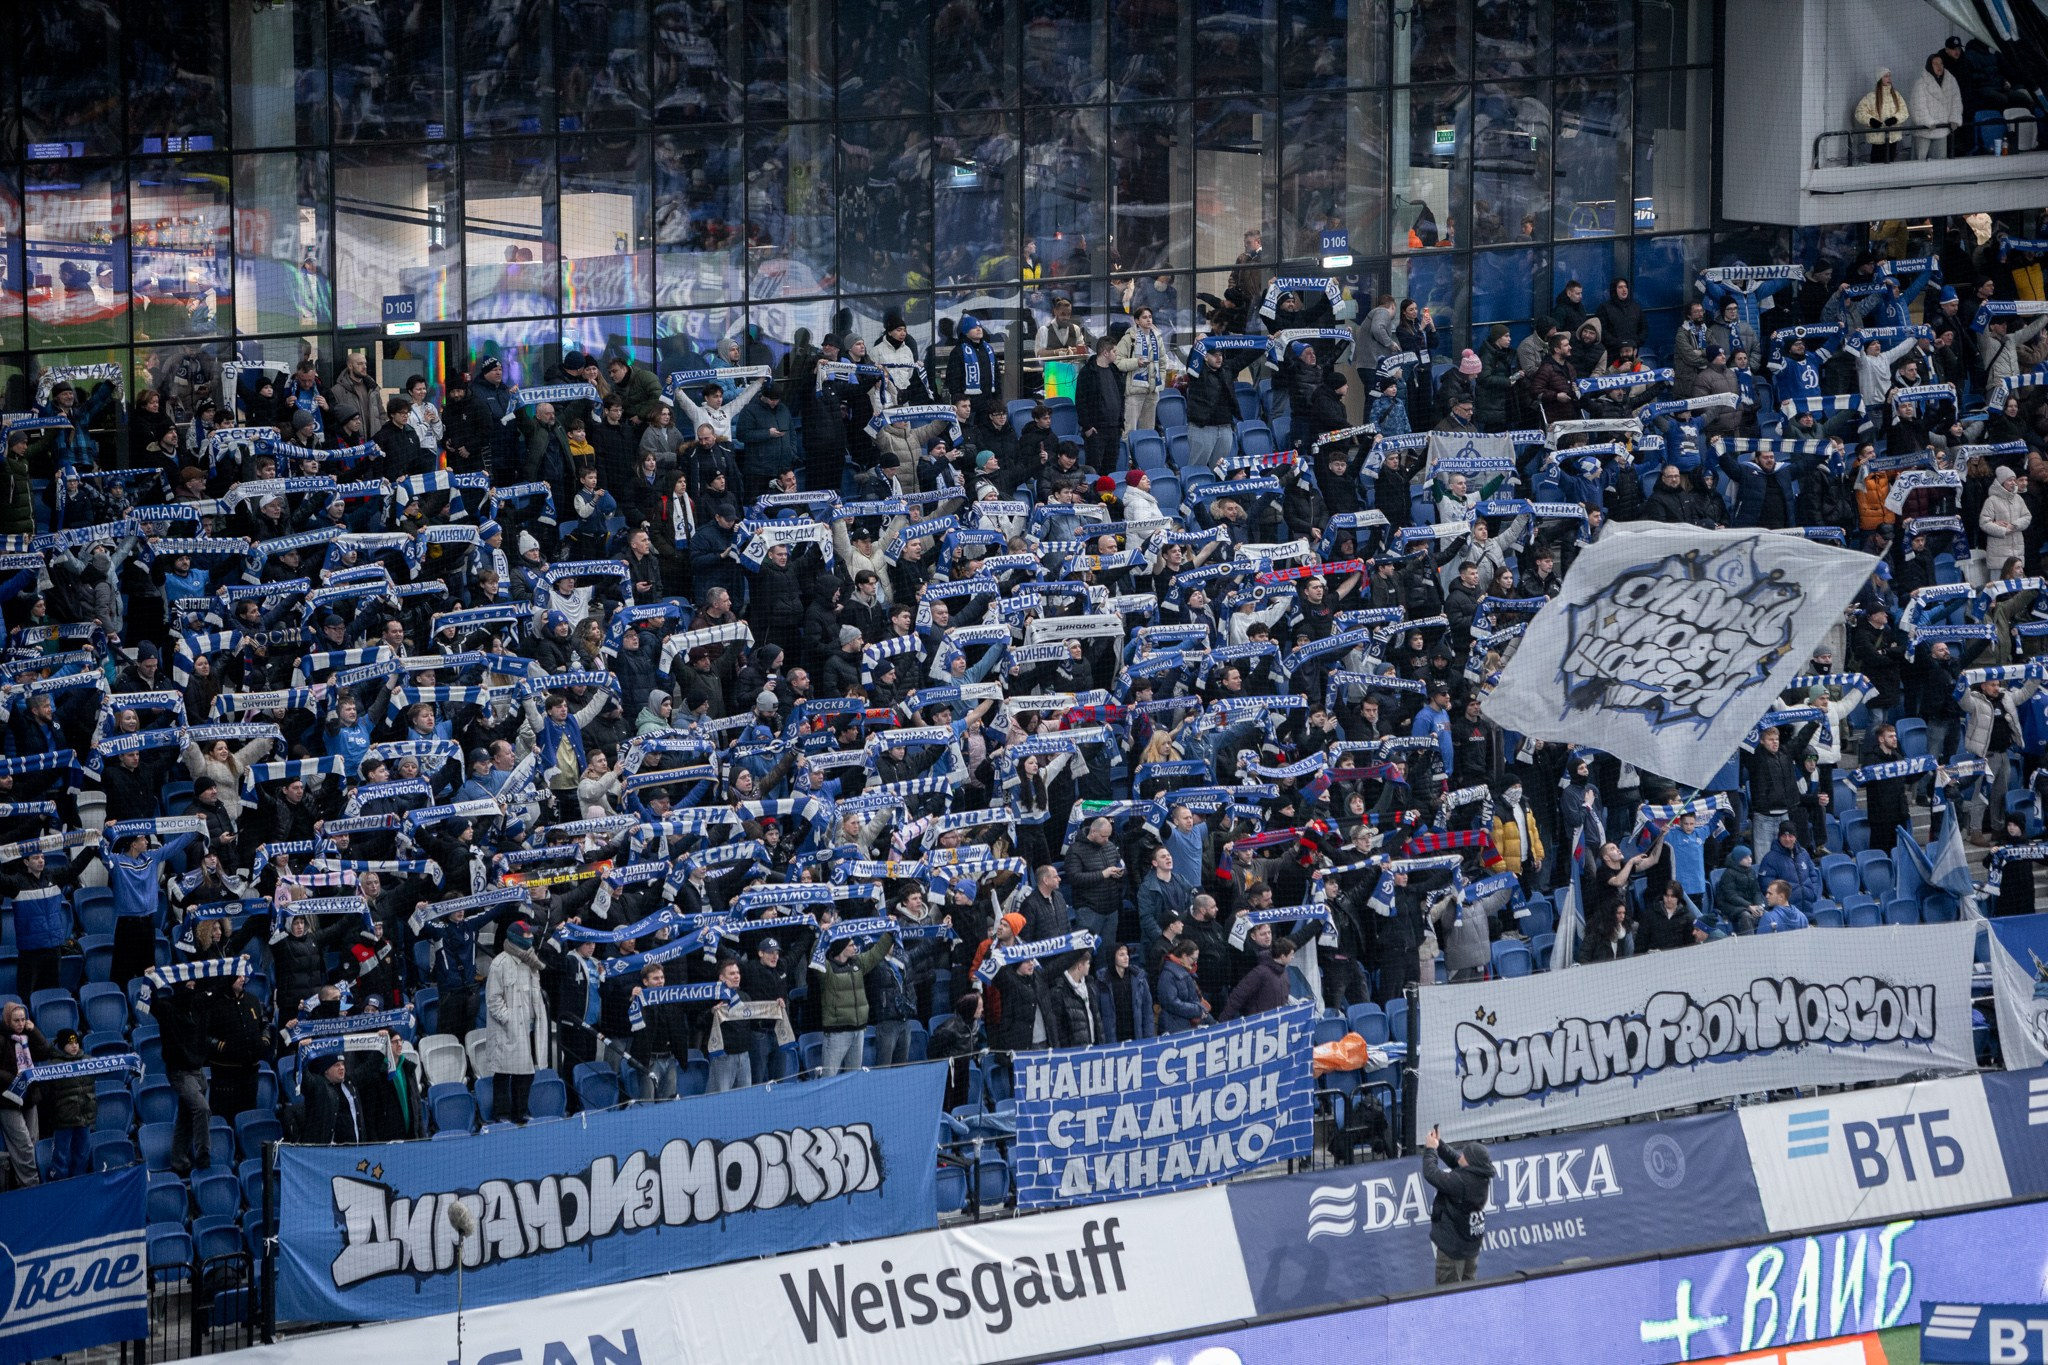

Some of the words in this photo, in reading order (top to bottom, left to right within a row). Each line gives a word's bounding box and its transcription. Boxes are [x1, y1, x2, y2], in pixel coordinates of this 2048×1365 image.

[1323, 238, 1329, 248] D
[1331, 237, 1346, 247] 106
[1722, 266, 1790, 279] ДИНАМО
[1278, 278, 1327, 288] ДИНАМО
[385, 303, 393, 315] D
[396, 300, 413, 315] 105
[1806, 325, 1839, 335] DYNAMO
[1216, 340, 1254, 348] ДИНАМО
[676, 369, 716, 382] ДИНАМО
[521, 384, 598, 402] ДИНАМО
[1656, 401, 1685, 410] ДИНАМО
[1691, 393, 1732, 404] МОСКВА
[245, 483, 282, 493] ДИНАМО
[290, 480, 330, 488] МОСКВА
[336, 480, 379, 493] ИНАМО
[1199, 483, 1234, 498] FORZA
[1236, 478, 1279, 491] DYNAMO
[132, 506, 193, 521] ДИНАМО
[1534, 503, 1583, 517] ИНАМО
[774, 527, 815, 542] ФКДМ
[906, 518, 951, 538] DYNAMO
[1403, 527, 1434, 537] ДИНАМО
[260, 530, 340, 554] ДИНАМО
[429, 530, 476, 542] ДИНАМО
[1260, 543, 1299, 558] ФКДМ
[587, 564, 626, 576] МОСКВА
[983, 554, 1034, 572] ДИНАМО
[1079, 558, 1095, 567] ЛЕВ
[1178, 568, 1218, 583] DYNAMO
[932, 586, 965, 599] ИНАМО
[1265, 585, 1296, 595] DYNAM
[1357, 616, 1386, 624] МОСКВА
[959, 629, 1004, 643] ДИНАМО
[1016, 646, 1064, 662] ДИНАМО
[1300, 640, 1336, 658] ДИНАМО
[340, 661, 397, 685] ДИНАМО
[533, 671, 605, 690] ДИНАМО
[115, 693, 169, 708] ДИНАМО
[926, 689, 958, 699] ДИНАМО
[965, 687, 996, 695] МОСКВА
[806, 701, 851, 711] МОСКВА
[1018, 699, 1065, 709] ФКДМ
[1234, 696, 1300, 707] ДИНАМО
[1779, 710, 1813, 720] ДИНАМО
[893, 730, 944, 744] ДИНАМО
[1151, 764, 1191, 778] Динамо
[1283, 758, 1317, 774] МОСКВА
[1874, 758, 1926, 780] FCDM
[415, 807, 452, 820] ДИНАМО
[459, 801, 495, 812] МОСКВА
[112, 822, 152, 832] ДИНАМО
[161, 819, 203, 828] МОСКВА
[330, 815, 382, 832] ДИНАМО
[565, 819, 627, 835] ДИНАМО
[610, 869, 622, 879] ФК
[626, 862, 664, 876] ДИНАМО
[623, 874, 650, 883] МОСКВА
[750, 891, 812, 905] ДИНАМО
[300, 898, 364, 914] ДИНАМО
[836, 920, 896, 935] МОСКВА
[648, 984, 714, 1004] ДИНАМО
[311, 1019, 349, 1033] ДИНАМО
[353, 1015, 393, 1027] МОСКВА
[301, 1039, 340, 1055] ДИНАМО
[31, 1062, 75, 1077] ДИНАМО
[78, 1057, 126, 1070] МОСКВА
[1025, 1054, 1143, 1101] НАШИ
[1047, 1071, 1280, 1149] СТАДИОН
[1842, 1108, 1966, 1190] ВТБ
[1362, 1143, 1623, 1234] БАТИКА
[780, 1216, 1128, 1345] Weissgauff
[1988, 1318, 2048, 1364] ВТ
